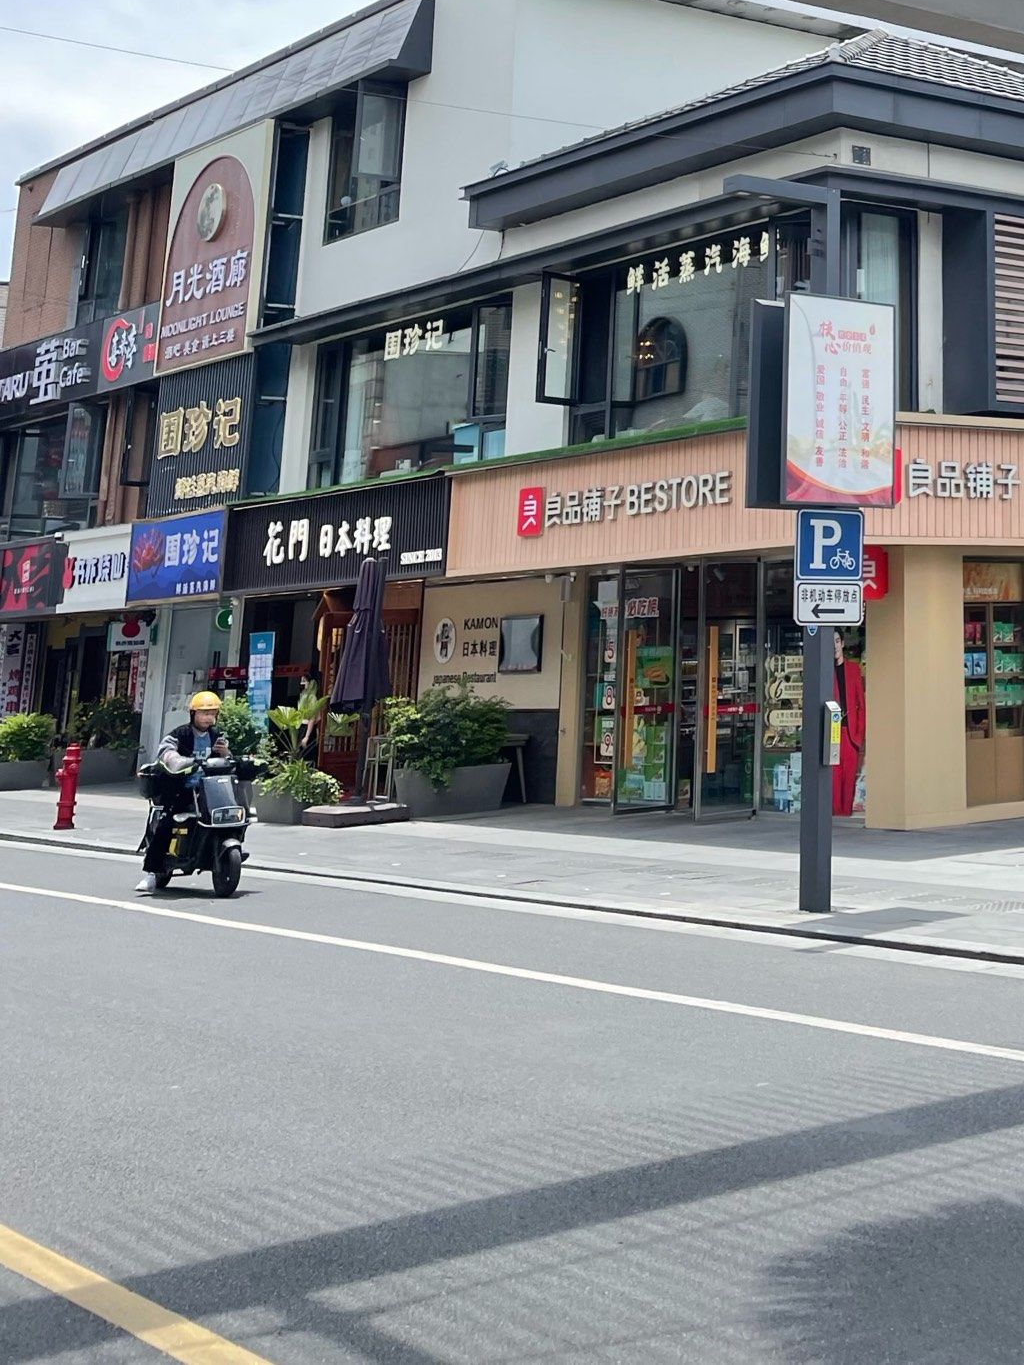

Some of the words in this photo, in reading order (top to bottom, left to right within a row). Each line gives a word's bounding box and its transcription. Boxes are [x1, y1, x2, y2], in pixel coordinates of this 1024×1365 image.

[166, 249, 249, 307] 月光酒廊
[161, 313, 208, 339] MOONLIGHT
[209, 301, 245, 324] LOUNGE
[62, 337, 83, 360] Bar
[60, 362, 83, 388] Cafe
[909, 458, 1021, 501] 良品铺子
[545, 485, 623, 528] 良品铺子
[626, 471, 731, 517] BESTORE
[319, 516, 393, 558] 日本料理
[809, 518, 842, 569] P
[801, 588, 858, 603] 非机动车停放点
[463, 617, 498, 631] KAMON
[463, 639, 497, 657] 日本料理
